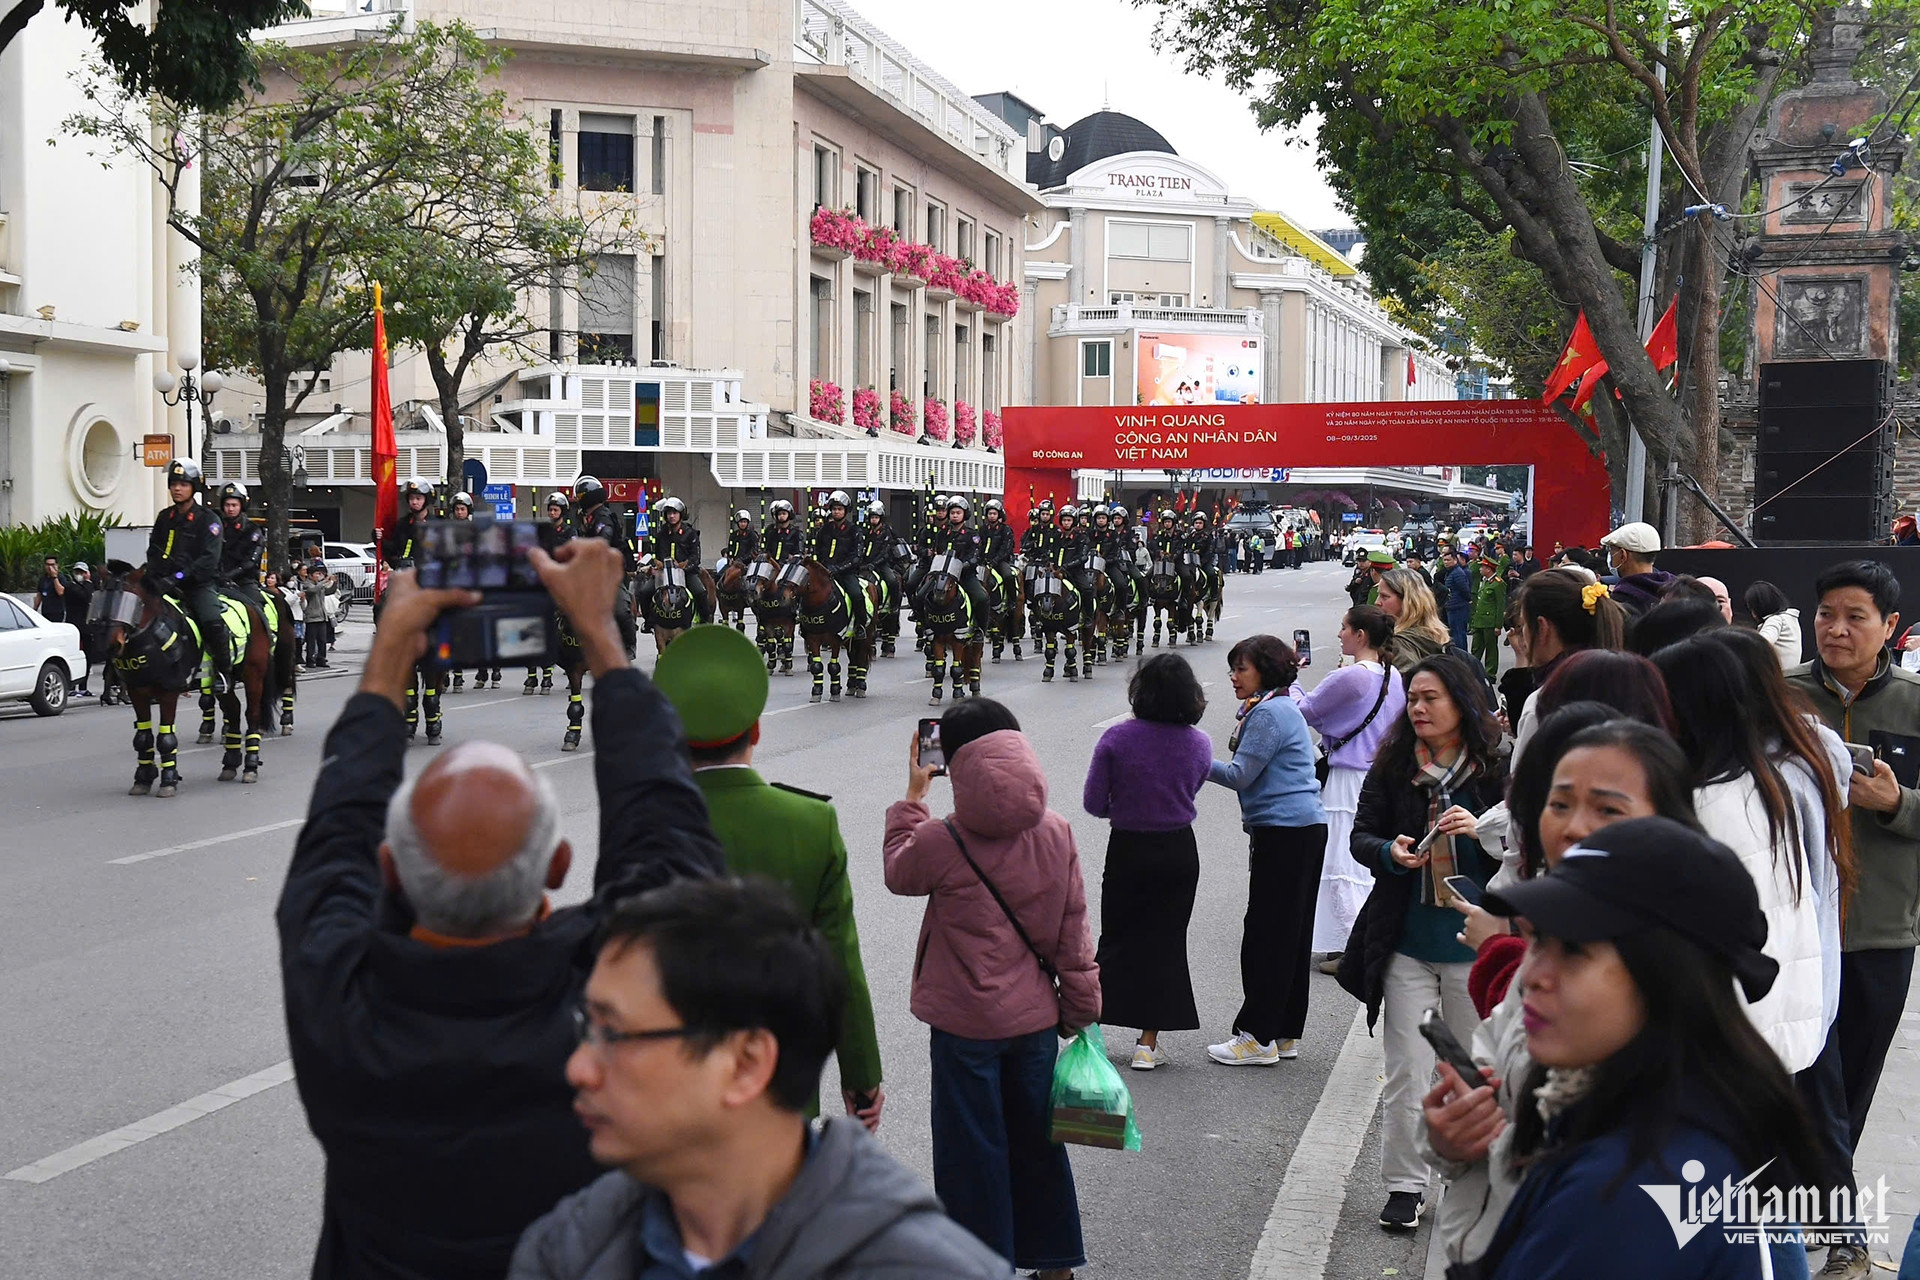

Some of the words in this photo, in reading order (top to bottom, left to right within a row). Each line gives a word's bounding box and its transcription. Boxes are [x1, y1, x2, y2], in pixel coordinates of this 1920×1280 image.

[1108, 173, 1155, 188] TRANG
[1158, 176, 1191, 190] TIEN
[1136, 190, 1164, 198] PLAZA
[1115, 415, 1156, 427] VINH
[1162, 414, 1225, 428] QUANG
[1115, 431, 1162, 444] CÔNG
[1166, 432, 1188, 444] AN
[1192, 430, 1239, 443] NHÂN
[1244, 428, 1277, 442] DÂN
[148, 450, 169, 460] ATM
[1032, 450, 1044, 459] BỘ
[1045, 450, 1070, 459] CÔNG
[1115, 446, 1148, 462] VIỆT
[1152, 448, 1188, 459] NAM
[607, 484, 626, 499] JC
[761, 600, 779, 608] POLIC
[656, 609, 682, 619] POLICE
[928, 612, 956, 623] POLICE
[562, 633, 580, 647] POL
